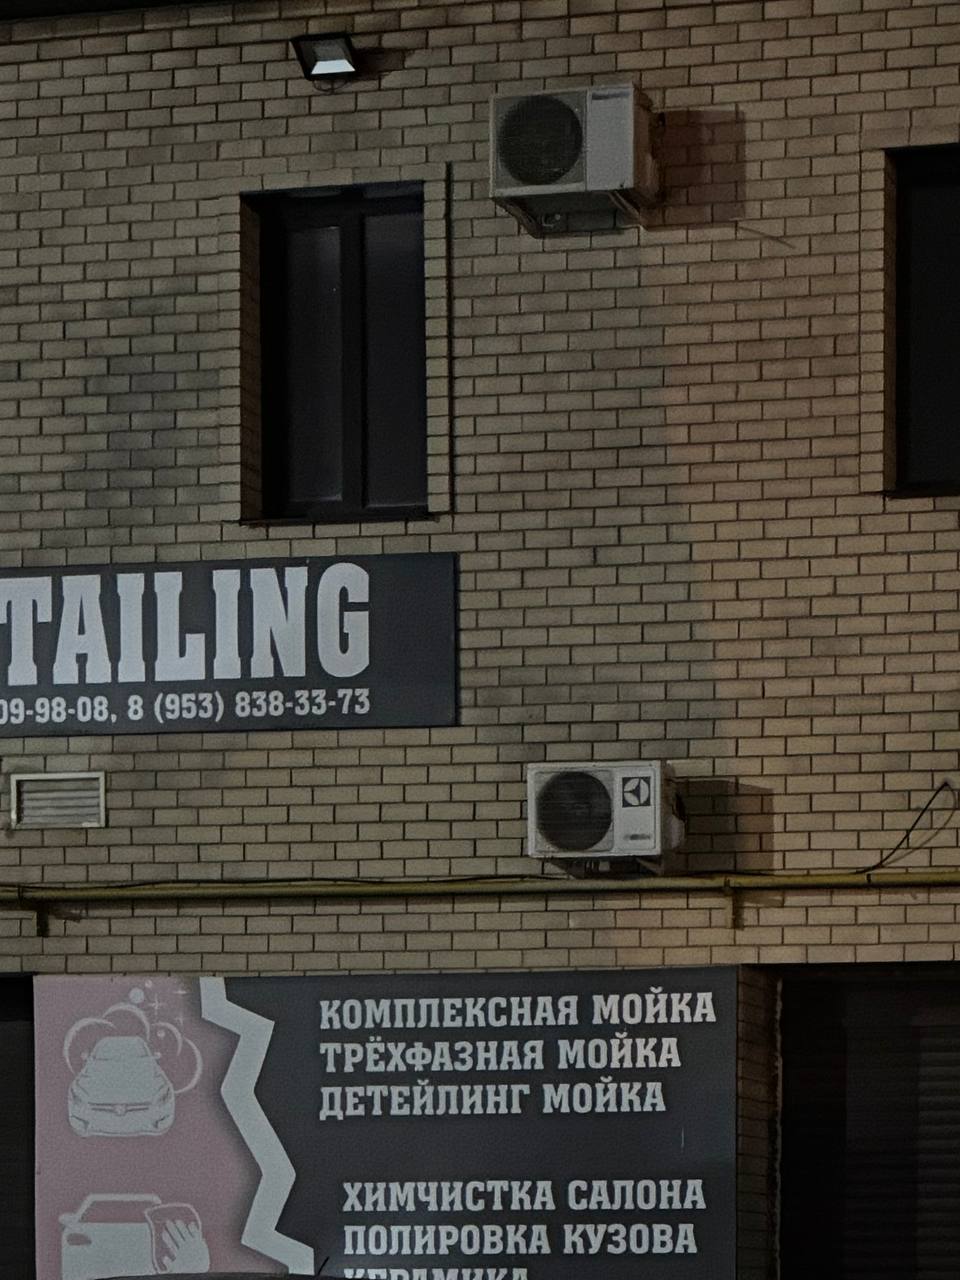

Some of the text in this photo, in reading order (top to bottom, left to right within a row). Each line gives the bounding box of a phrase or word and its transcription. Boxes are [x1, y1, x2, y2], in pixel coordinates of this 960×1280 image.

[126, 694, 144, 721] 8
[153, 690, 225, 724] (953)
[234, 687, 371, 718] 838-33-73
[319, 986, 717, 1030] КОМПЛЕКСНАЯ МОЙКА
[319, 1031, 682, 1073] ТРЁХФАЗНАЯ МОЙКА
[319, 1075, 667, 1121] ДЕТЕЙЛИНГ МОЙКА
[342, 1178, 707, 1212] ХИМЧИСТКА САЛОНА
[343, 1223, 698, 1256] ПОЛИРОВКА КУЗОВА
